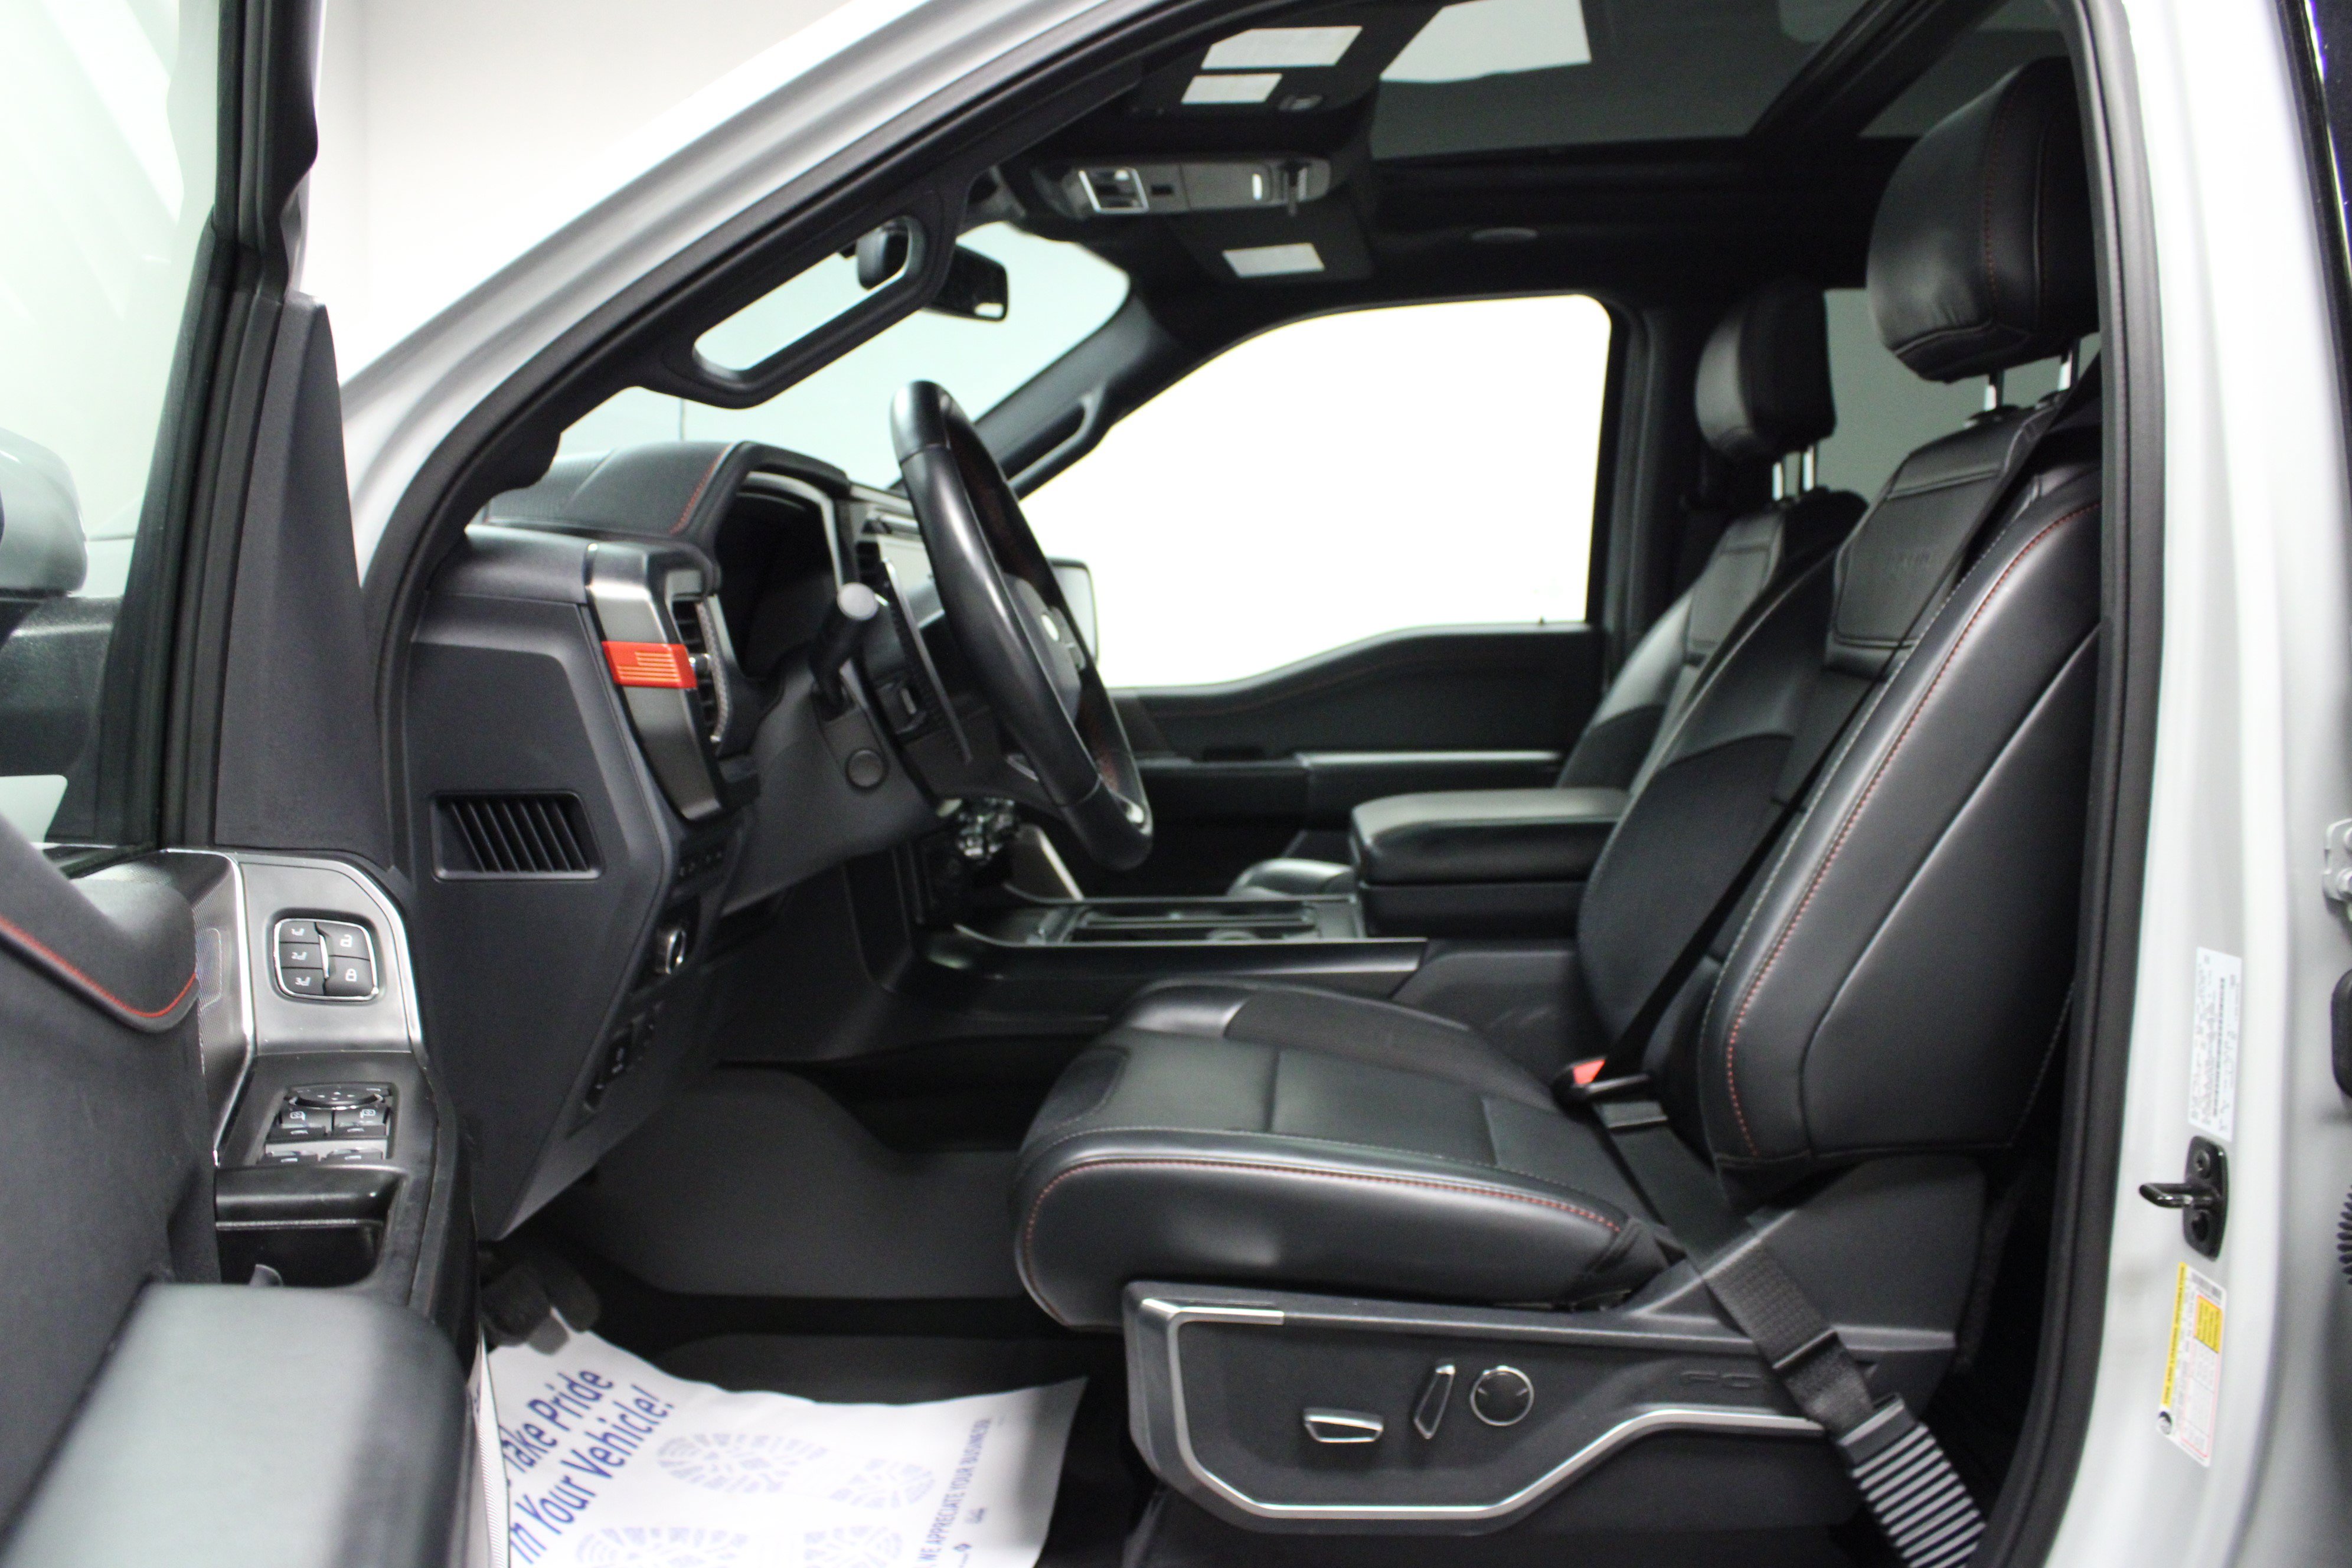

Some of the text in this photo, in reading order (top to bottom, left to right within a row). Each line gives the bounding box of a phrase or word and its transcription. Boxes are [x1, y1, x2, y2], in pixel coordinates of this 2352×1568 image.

[526, 1370, 615, 1432] Pride
[514, 1475, 596, 1536] Your
[560, 1383, 675, 1479] Vehicle!
[925, 1492, 966, 1546] APPRECIATE
